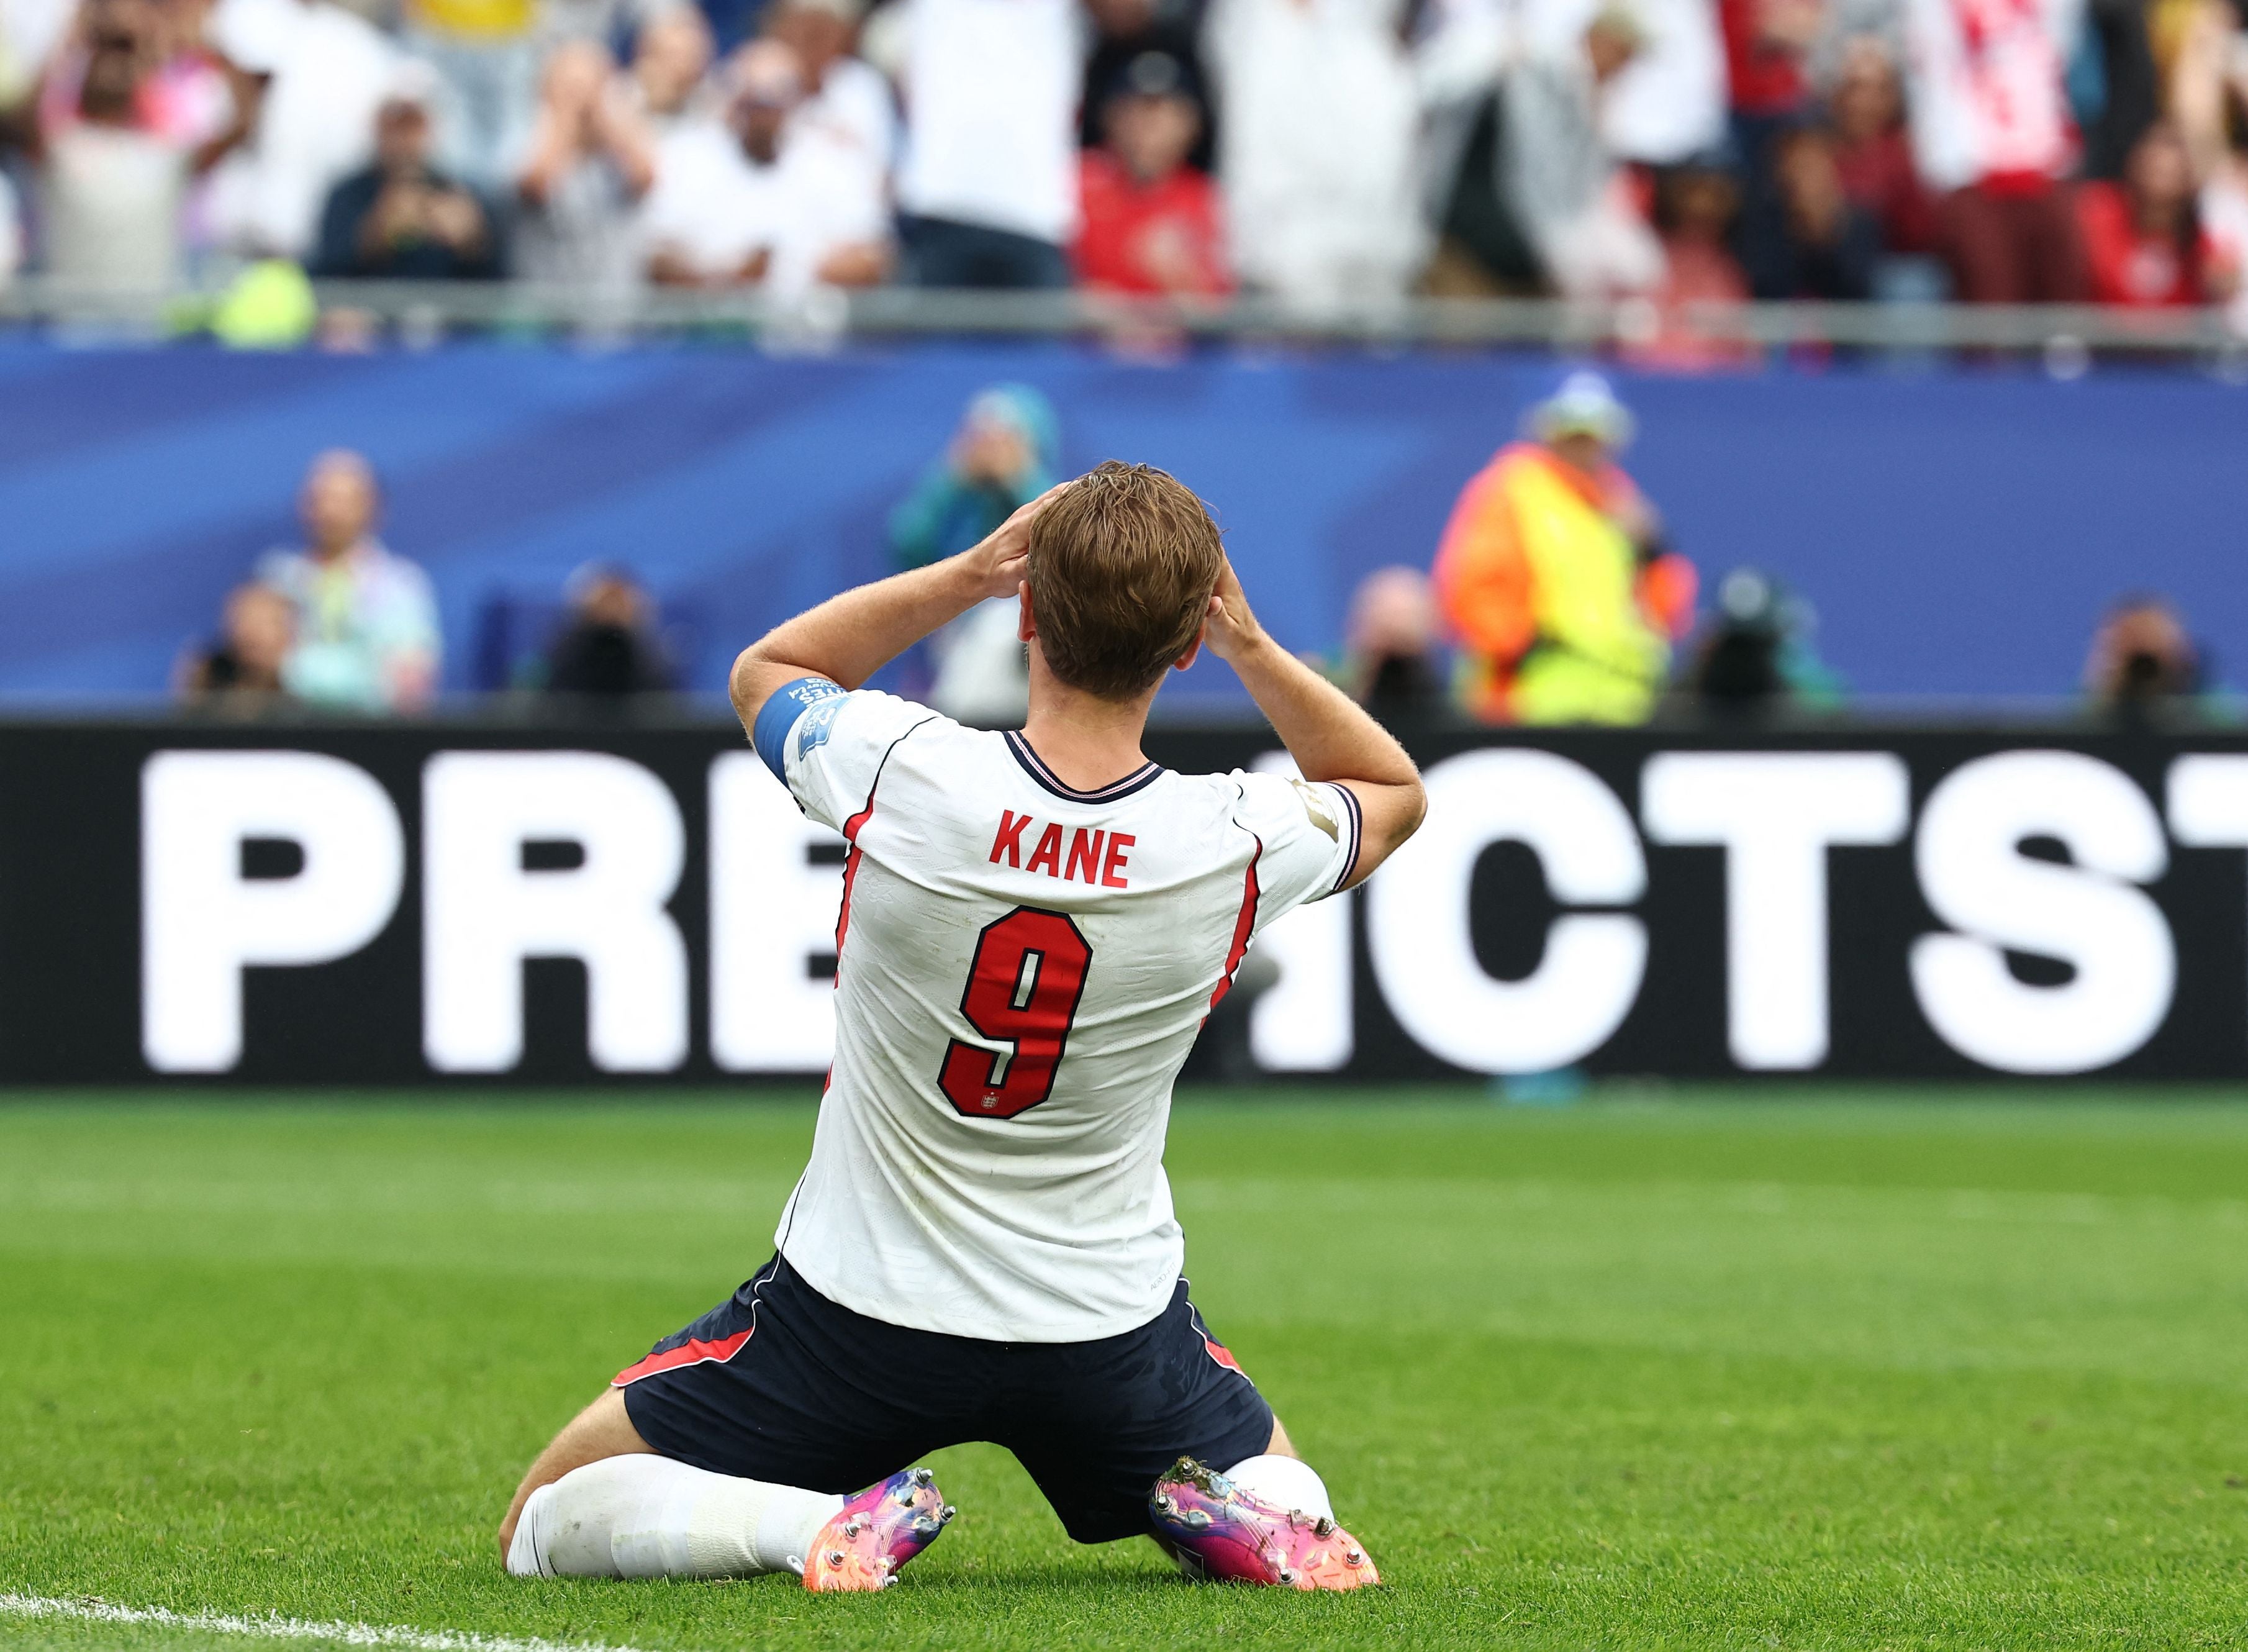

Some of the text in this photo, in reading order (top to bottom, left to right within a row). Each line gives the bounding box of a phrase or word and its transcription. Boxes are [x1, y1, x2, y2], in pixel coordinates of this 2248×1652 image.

[140, 750, 2248, 1073] PREICTS
[989, 809, 1136, 889] KANE
[936, 904, 1094, 1119] 9
